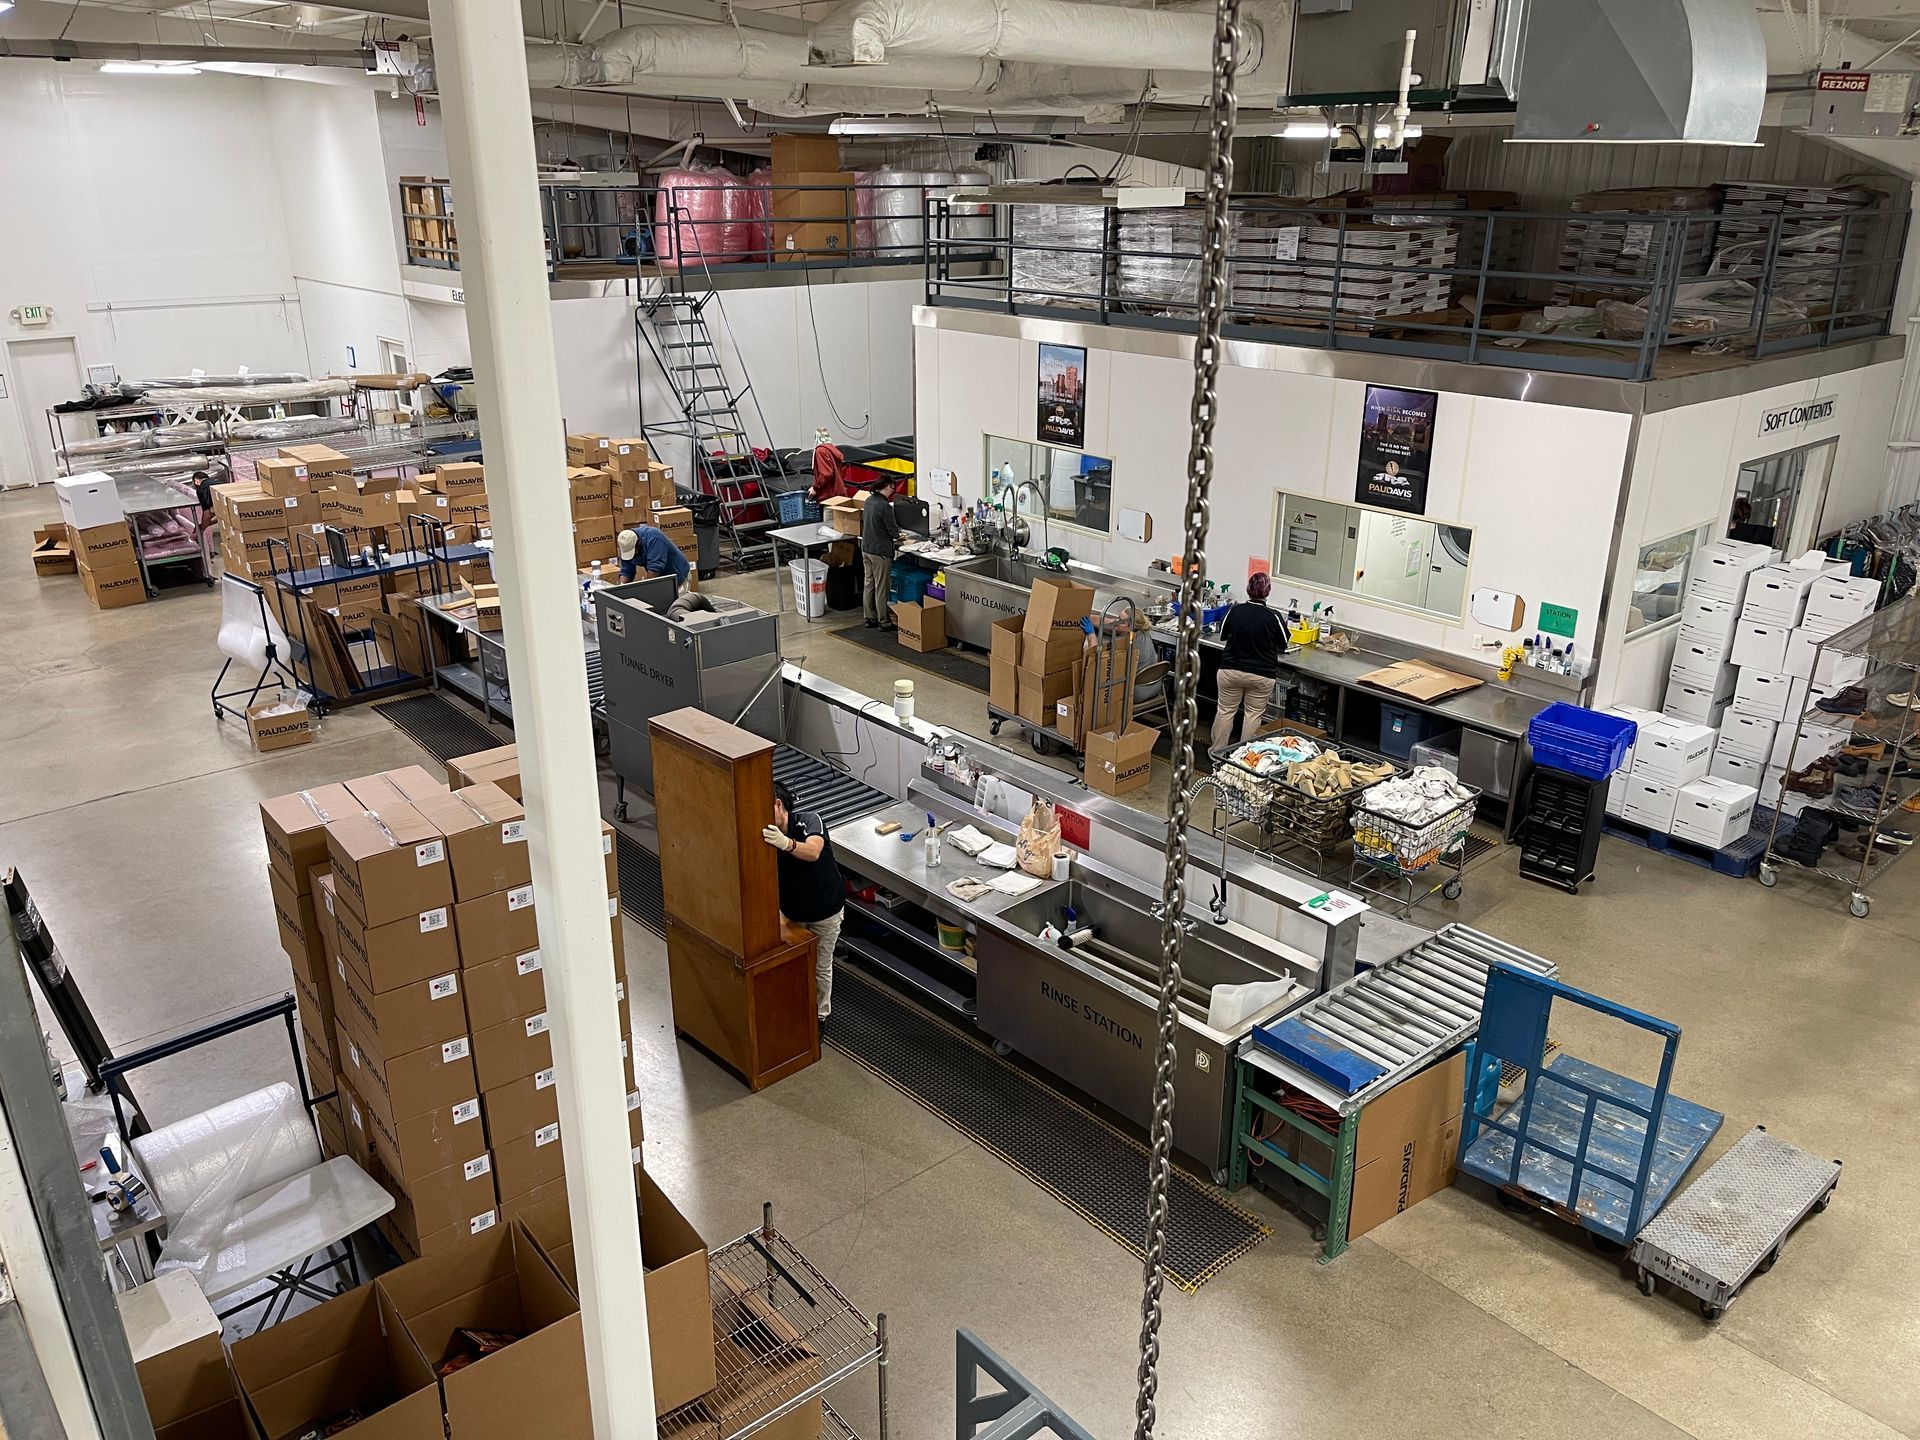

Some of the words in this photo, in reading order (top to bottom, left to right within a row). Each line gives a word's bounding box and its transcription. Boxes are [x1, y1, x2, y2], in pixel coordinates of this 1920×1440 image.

[1822, 80, 1866, 90] REZNOR
[25, 306, 42, 319] EXIT
[1402, 409, 1426, 418] BECOMES
[1763, 410, 1787, 432] SOFT
[1788, 400, 1834, 425] CONTENTS
[960, 590, 980, 604] HAND
[981, 597, 1016, 615] CLEANING
[1545, 608, 1571, 619] STATION
[618, 652, 649, 677] TUNNEL
[649, 666, 675, 689] DRYER
[1040, 980, 1078, 1014] RINSE
[1083, 1004, 1143, 1050] STATION
